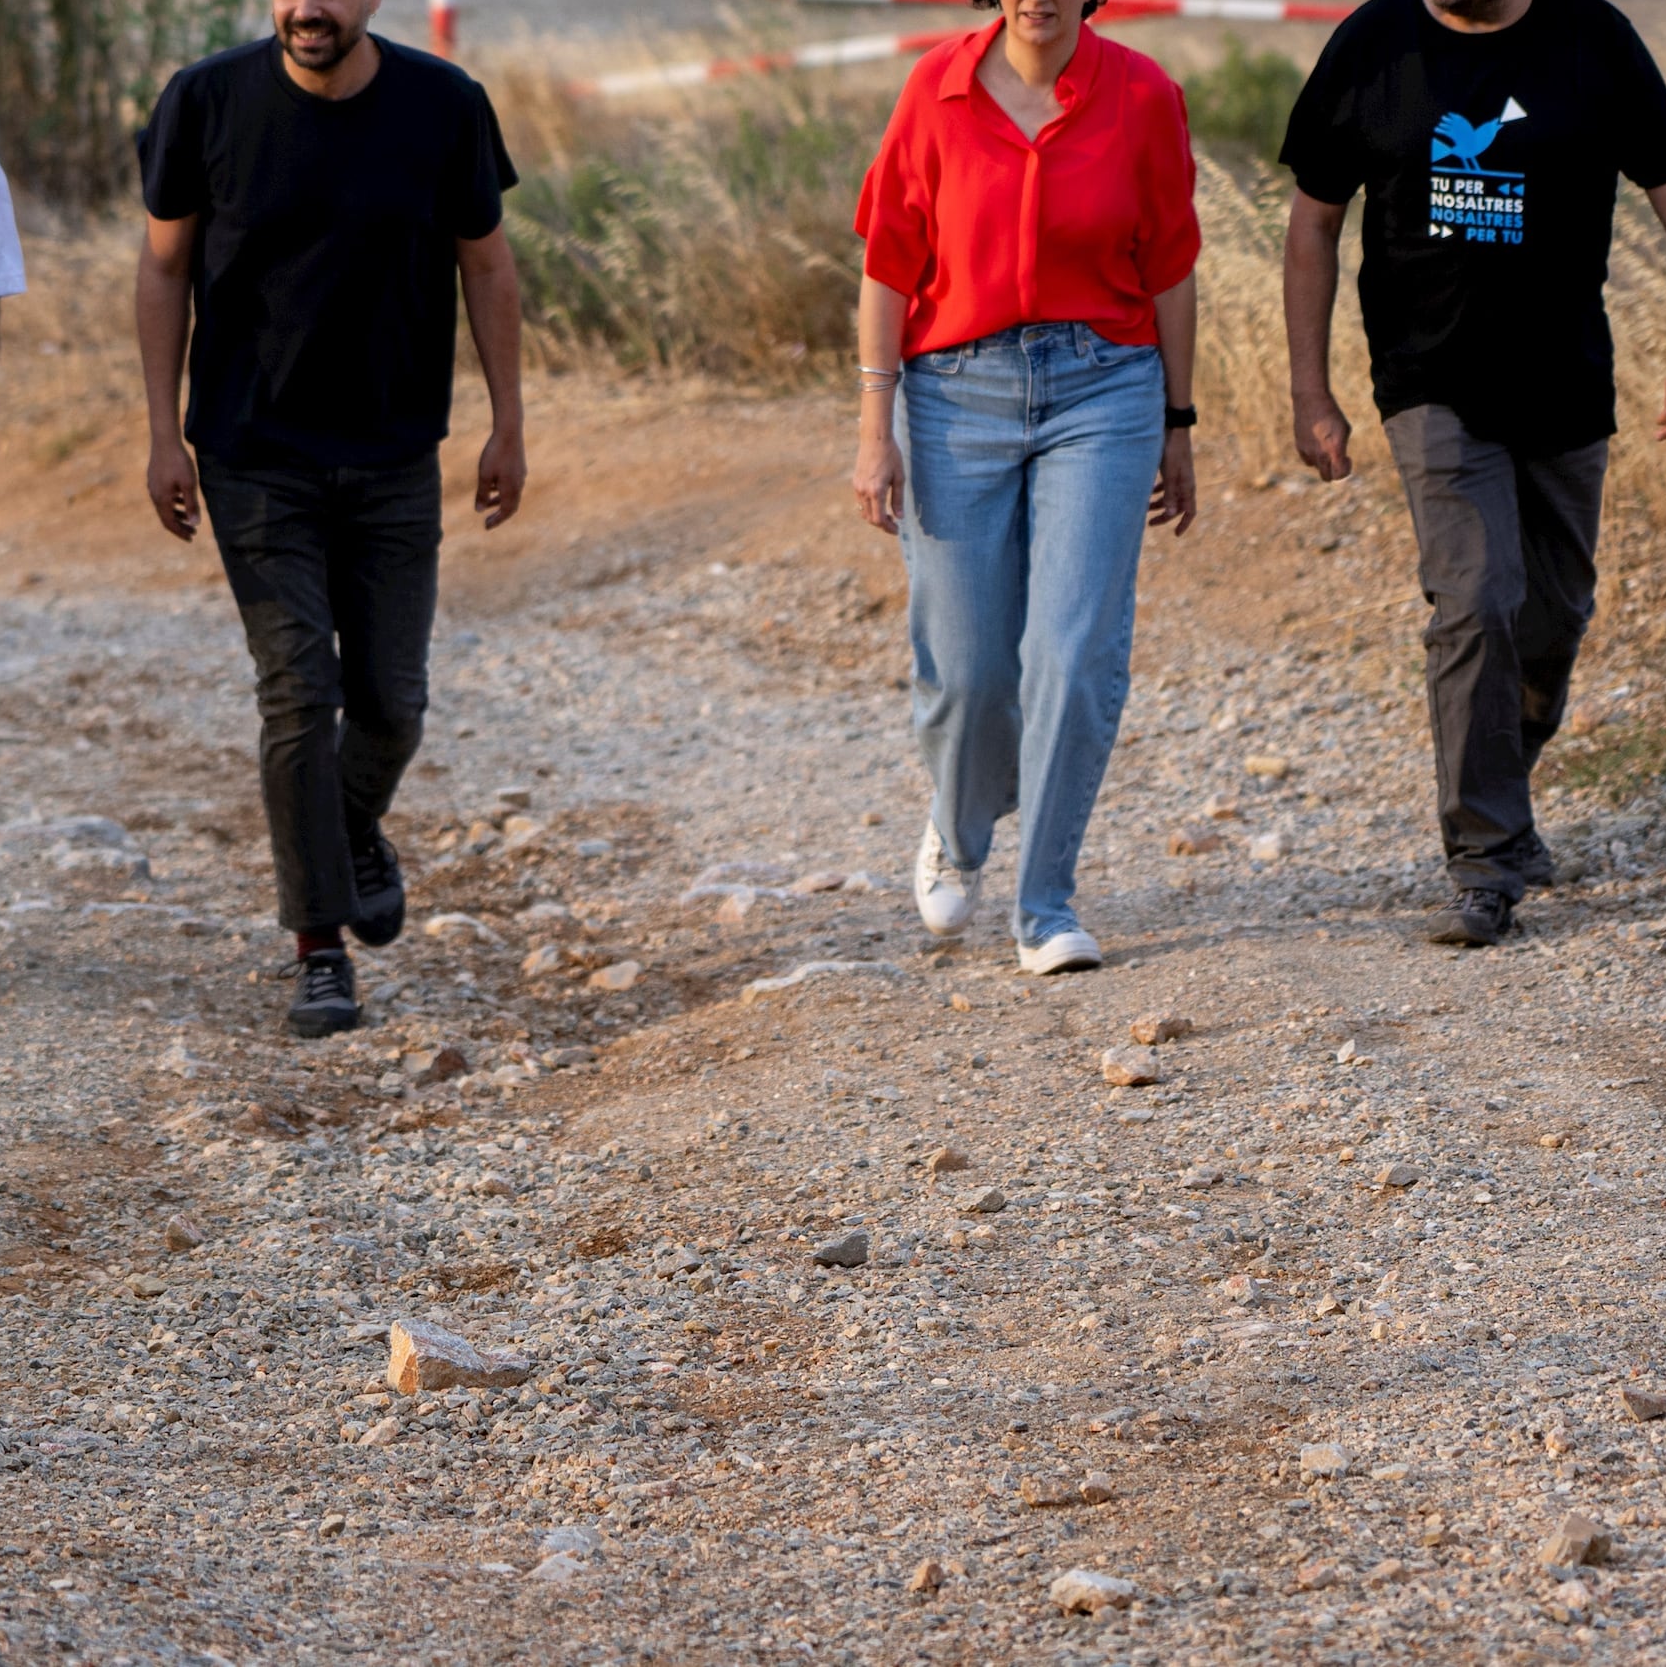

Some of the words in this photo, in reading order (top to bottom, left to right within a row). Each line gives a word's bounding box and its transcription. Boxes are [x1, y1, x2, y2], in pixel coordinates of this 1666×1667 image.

[1430, 177, 1450, 192] TU
[1454, 179, 1484, 195] PER
[1430, 192, 1524, 213] NOSALTRES
[1430, 207, 1524, 229] NOSALTRES
[1466, 227, 1496, 242] PER
[1502, 230, 1523, 244] TU
